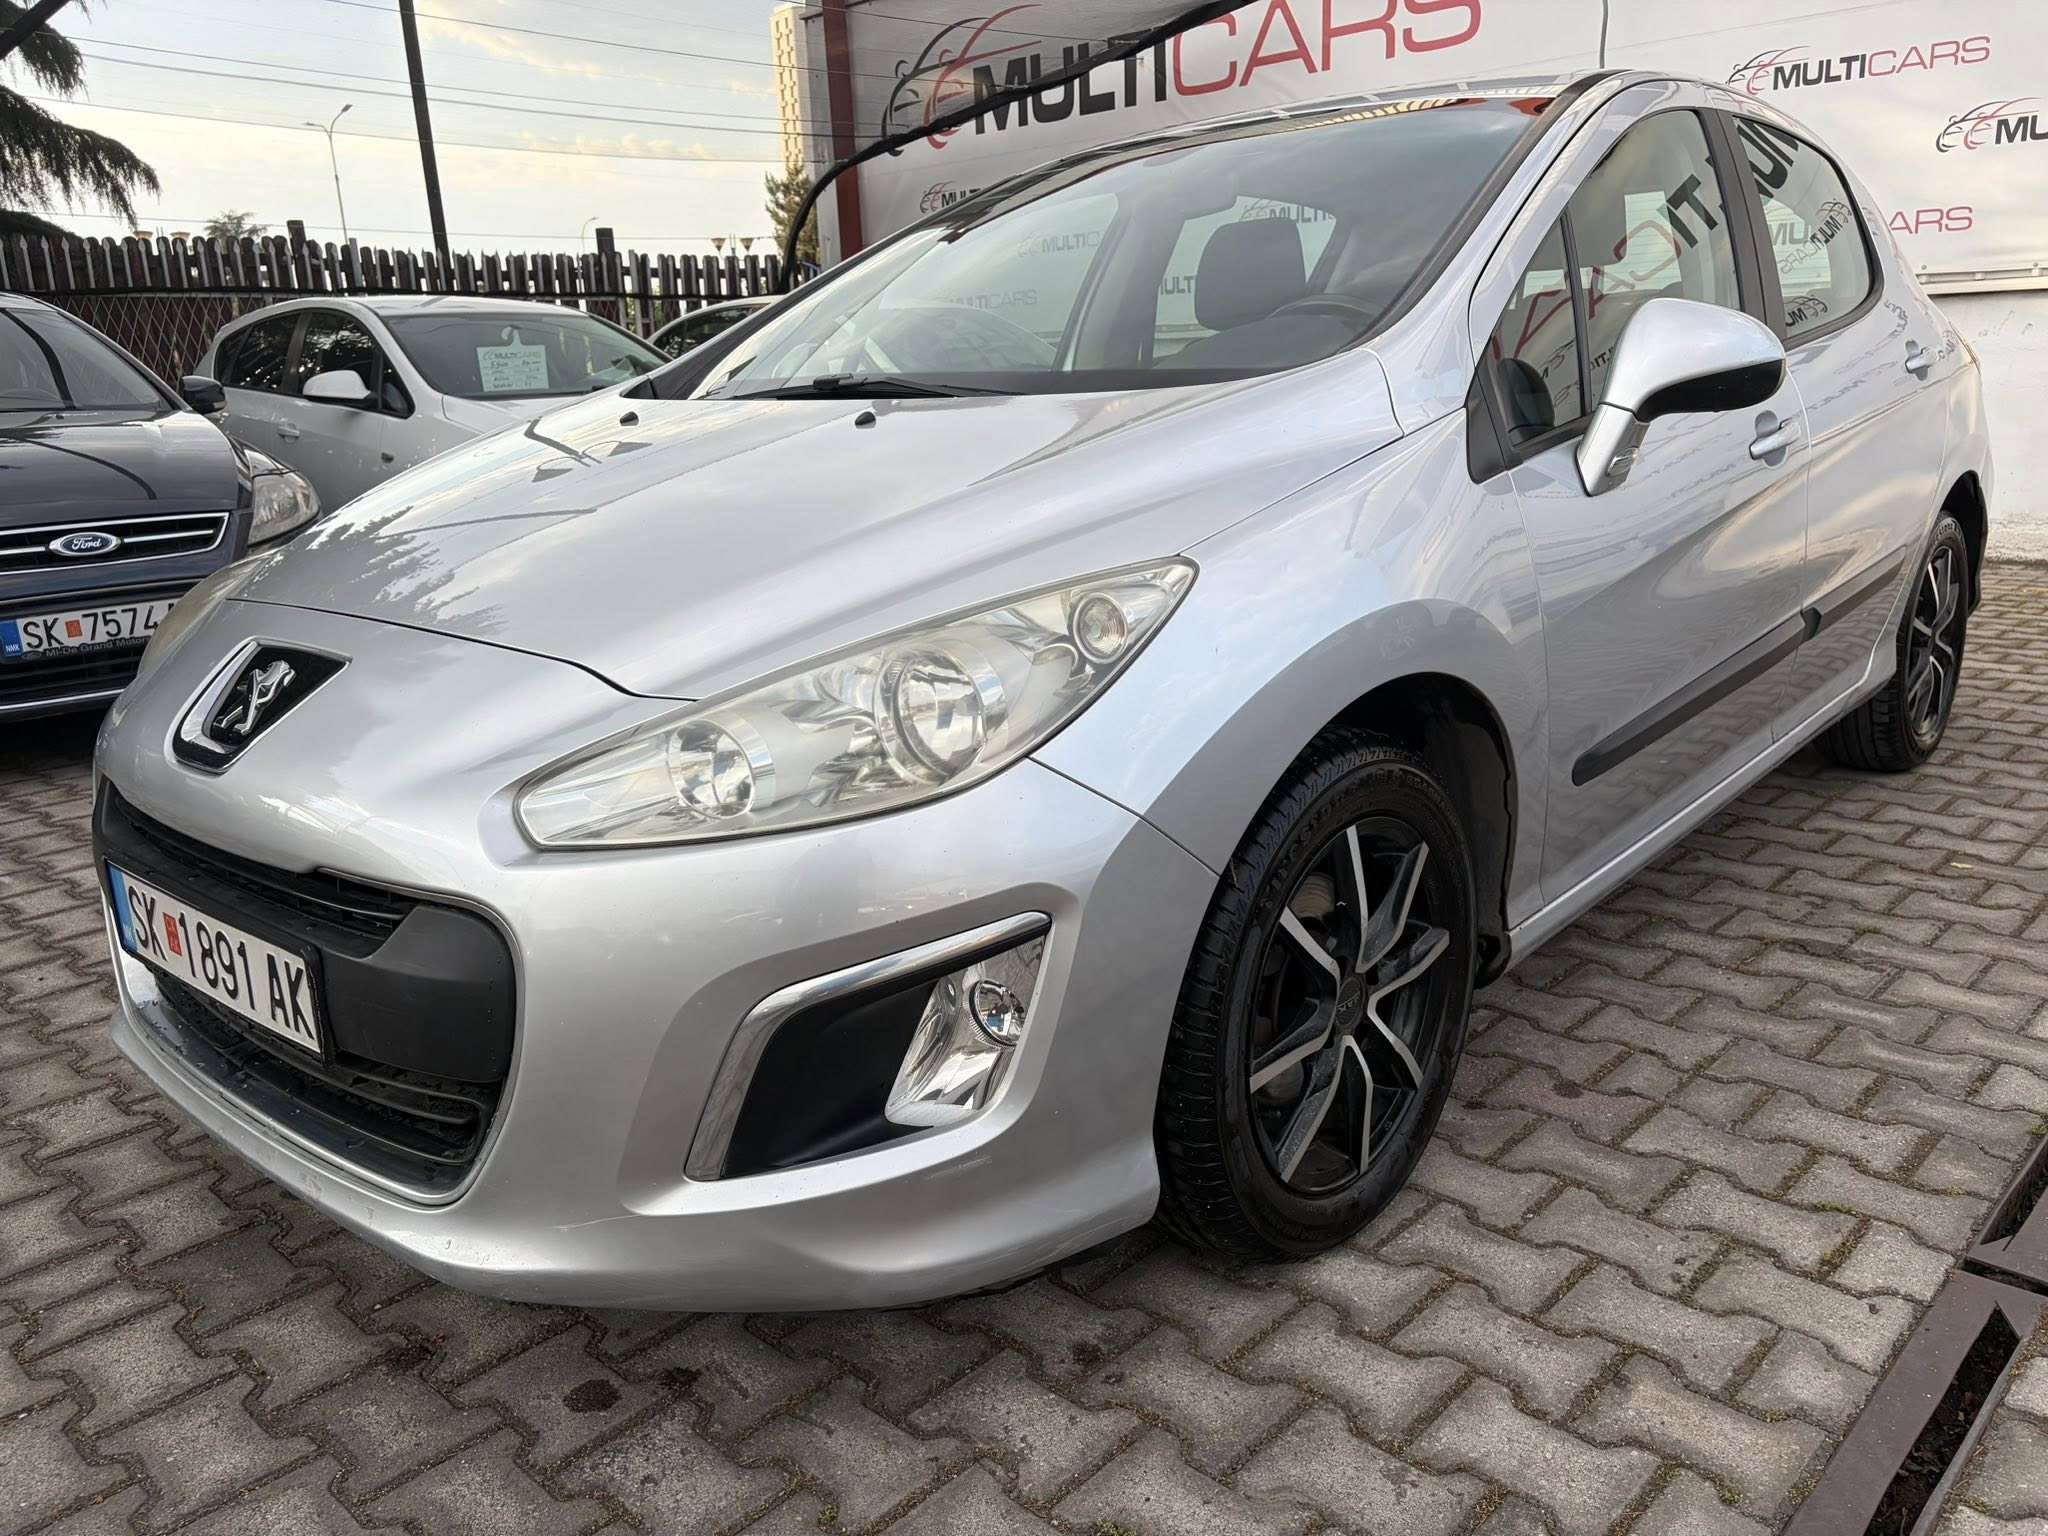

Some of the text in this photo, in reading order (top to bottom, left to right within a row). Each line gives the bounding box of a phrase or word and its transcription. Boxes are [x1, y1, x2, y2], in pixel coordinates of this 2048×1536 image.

[973, 0, 1482, 135] MULTICARS
[1773, 36, 1990, 90] MULTICARS
[71, 536, 102, 550] Ford
[22, 605, 159, 649] SK 7574
[128, 885, 315, 1040] SK 1891 AK
